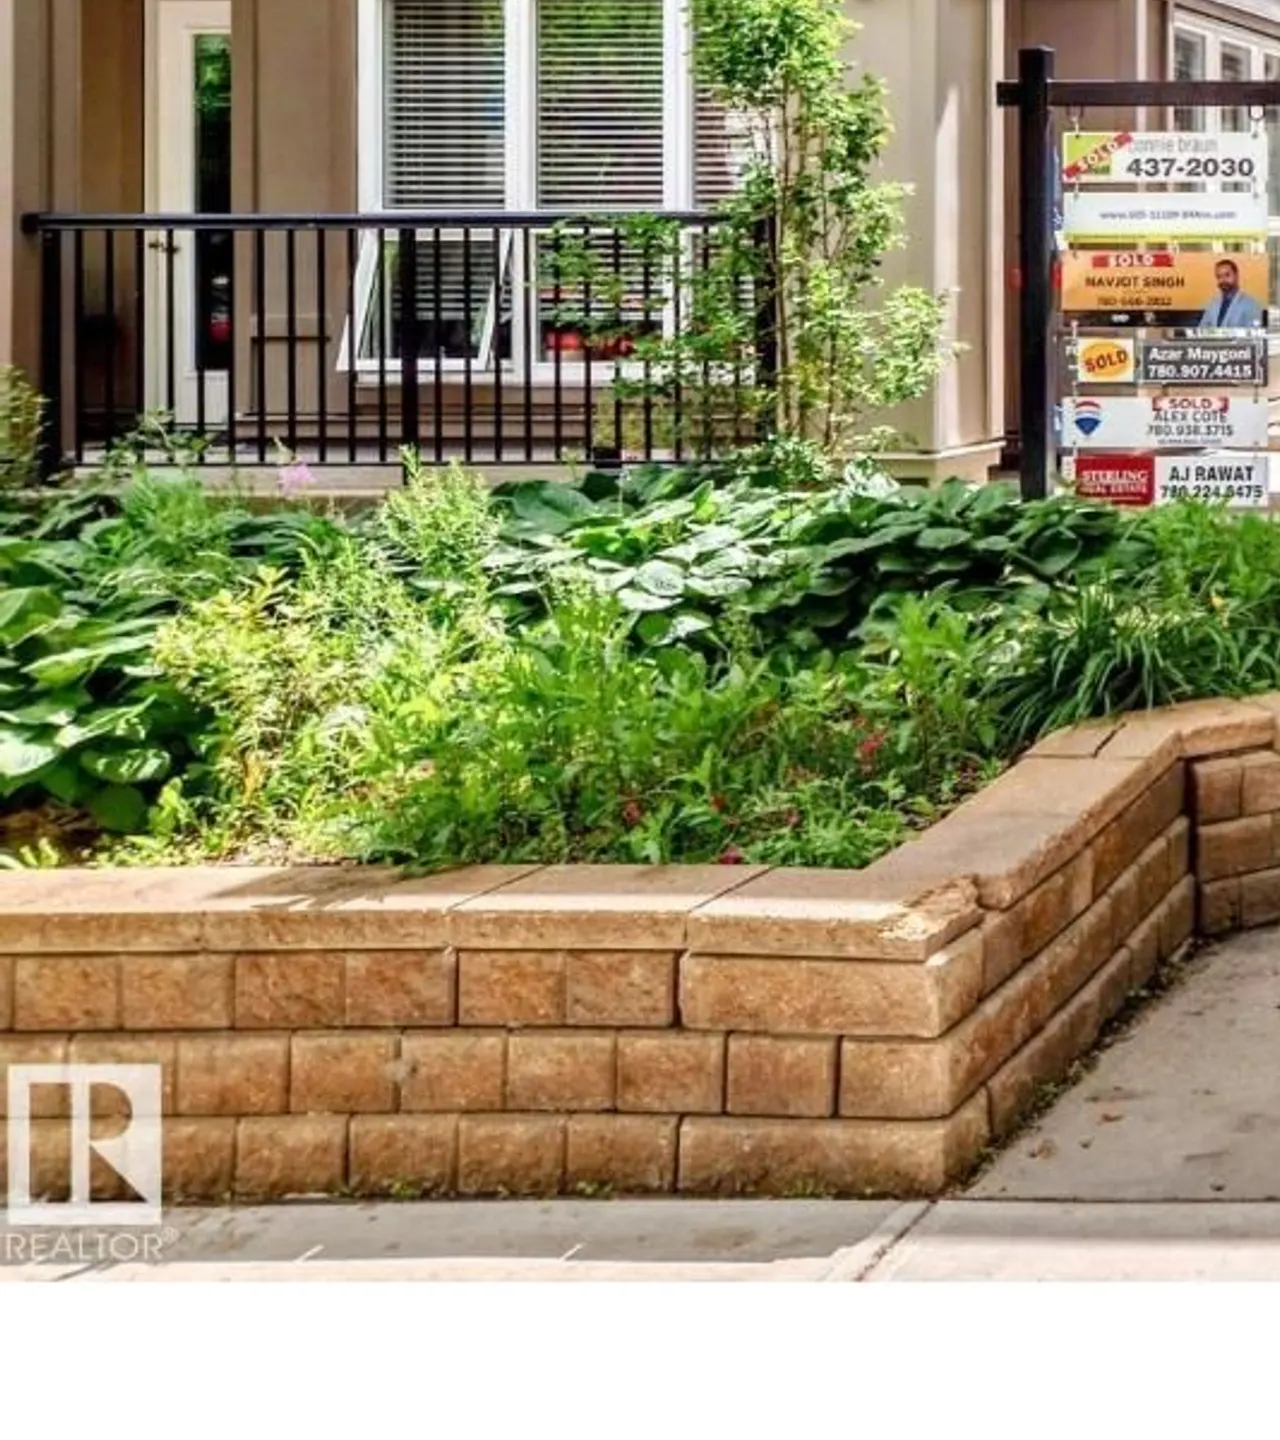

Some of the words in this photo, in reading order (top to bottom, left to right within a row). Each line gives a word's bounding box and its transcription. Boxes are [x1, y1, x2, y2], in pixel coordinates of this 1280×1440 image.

[1126, 158, 1254, 177] 437-2030
[1108, 254, 1154, 267] SOLD
[1085, 276, 1139, 289] NAVJOT
[1142, 276, 1185, 289] SINGH
[1149, 348, 1184, 361] Azar
[1083, 350, 1129, 374] SOLD
[1148, 364, 1252, 379] 780.907.4415
[1168, 397, 1213, 409] SOLD
[1153, 410, 1188, 422] ALEX
[1192, 410, 1229, 423] COTE
[1082, 469, 1149, 482] STERLING
[1169, 466, 1190, 482] AJ
[1195, 466, 1254, 481] RAWAT
